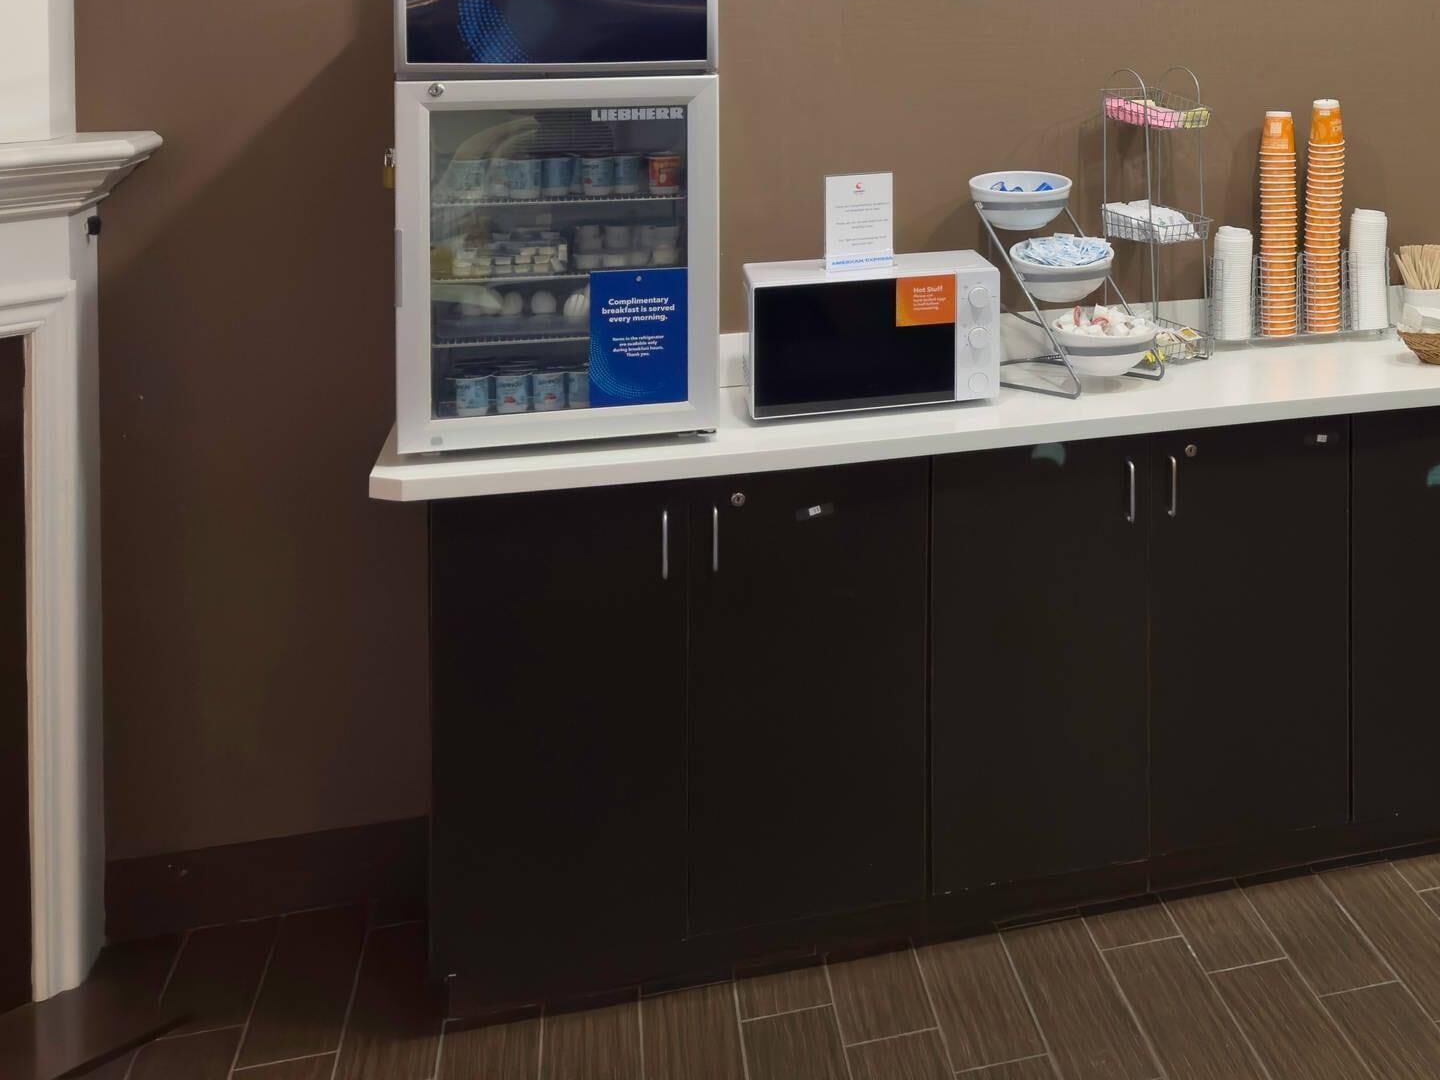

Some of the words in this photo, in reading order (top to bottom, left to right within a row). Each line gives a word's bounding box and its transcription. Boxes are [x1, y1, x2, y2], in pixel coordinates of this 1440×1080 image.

[591, 107, 685, 122] LIEBHERR
[927, 285, 943, 293] Stuff
[608, 297, 669, 306] Complimentary
[601, 305, 639, 315] breakfast
[648, 304, 675, 312] served
[609, 316, 631, 324] every
[632, 313, 669, 322] morning.
